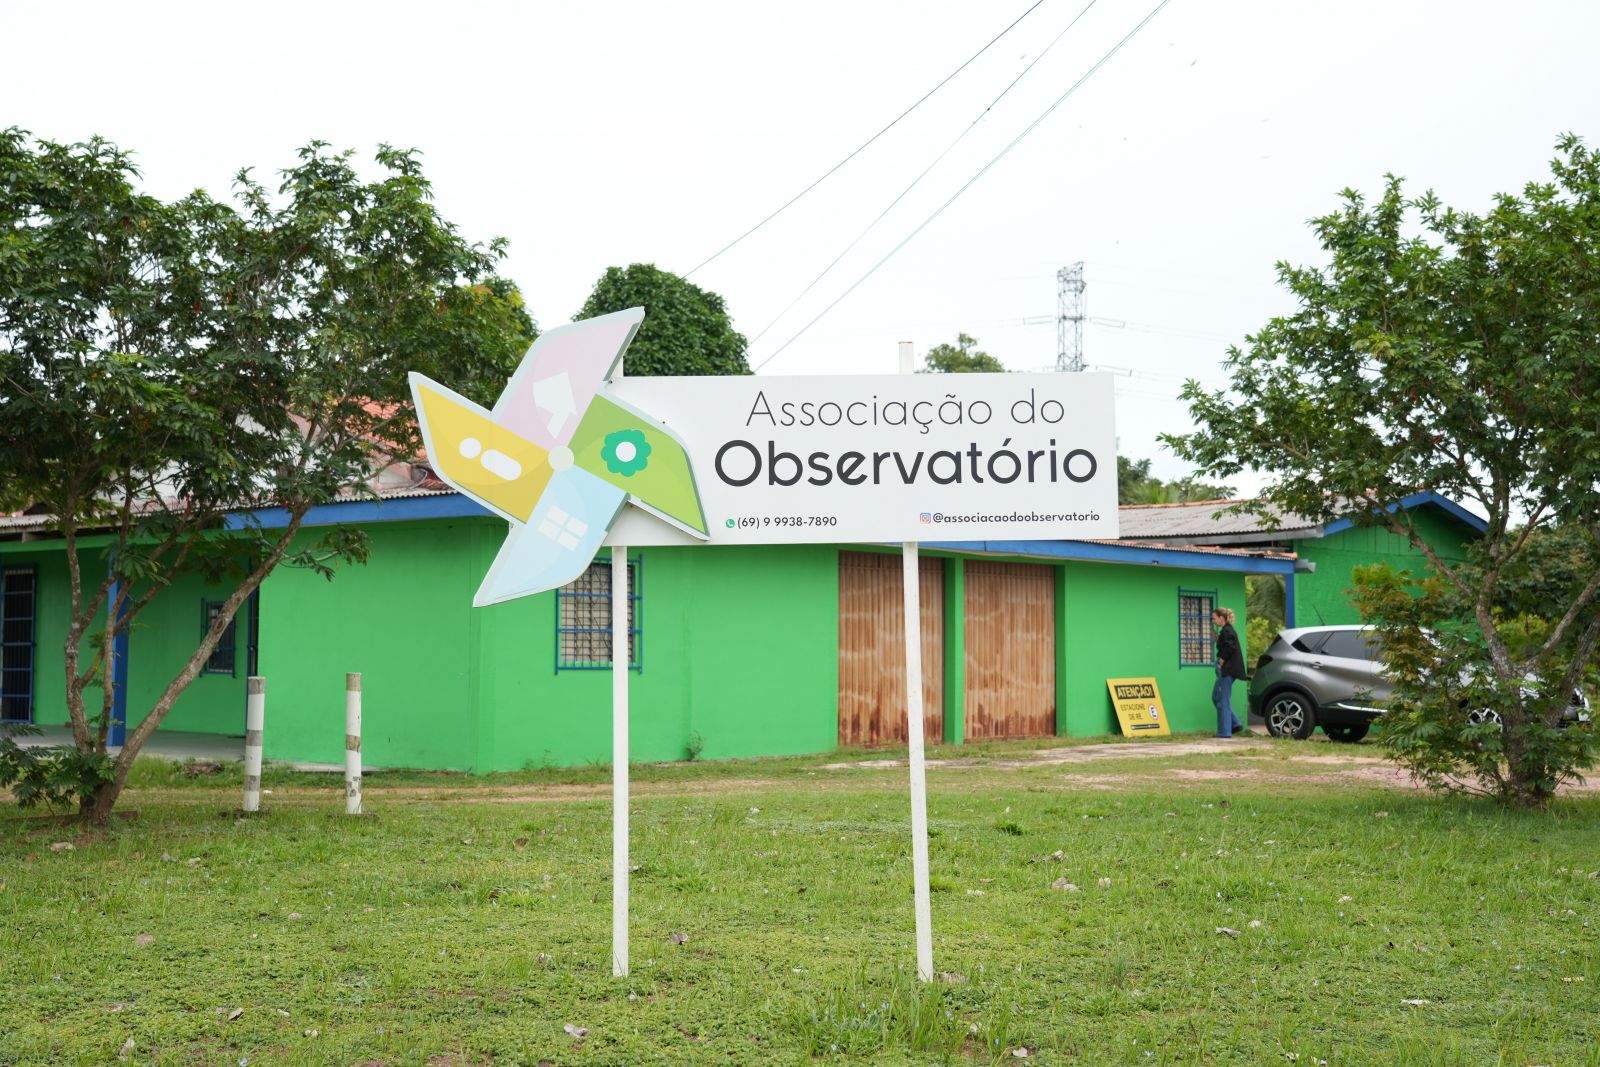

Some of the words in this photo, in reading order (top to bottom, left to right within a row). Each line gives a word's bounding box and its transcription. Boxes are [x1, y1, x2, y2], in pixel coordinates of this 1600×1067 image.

[746, 390, 993, 435] Associação
[1010, 387, 1066, 424] do
[714, 437, 1098, 487] Observatório
[737, 516, 761, 529] (69)
[763, 516, 771, 527] 9
[774, 516, 837, 527] 9938-7890
[932, 511, 1100, 523] @associacaodoobservatorio
